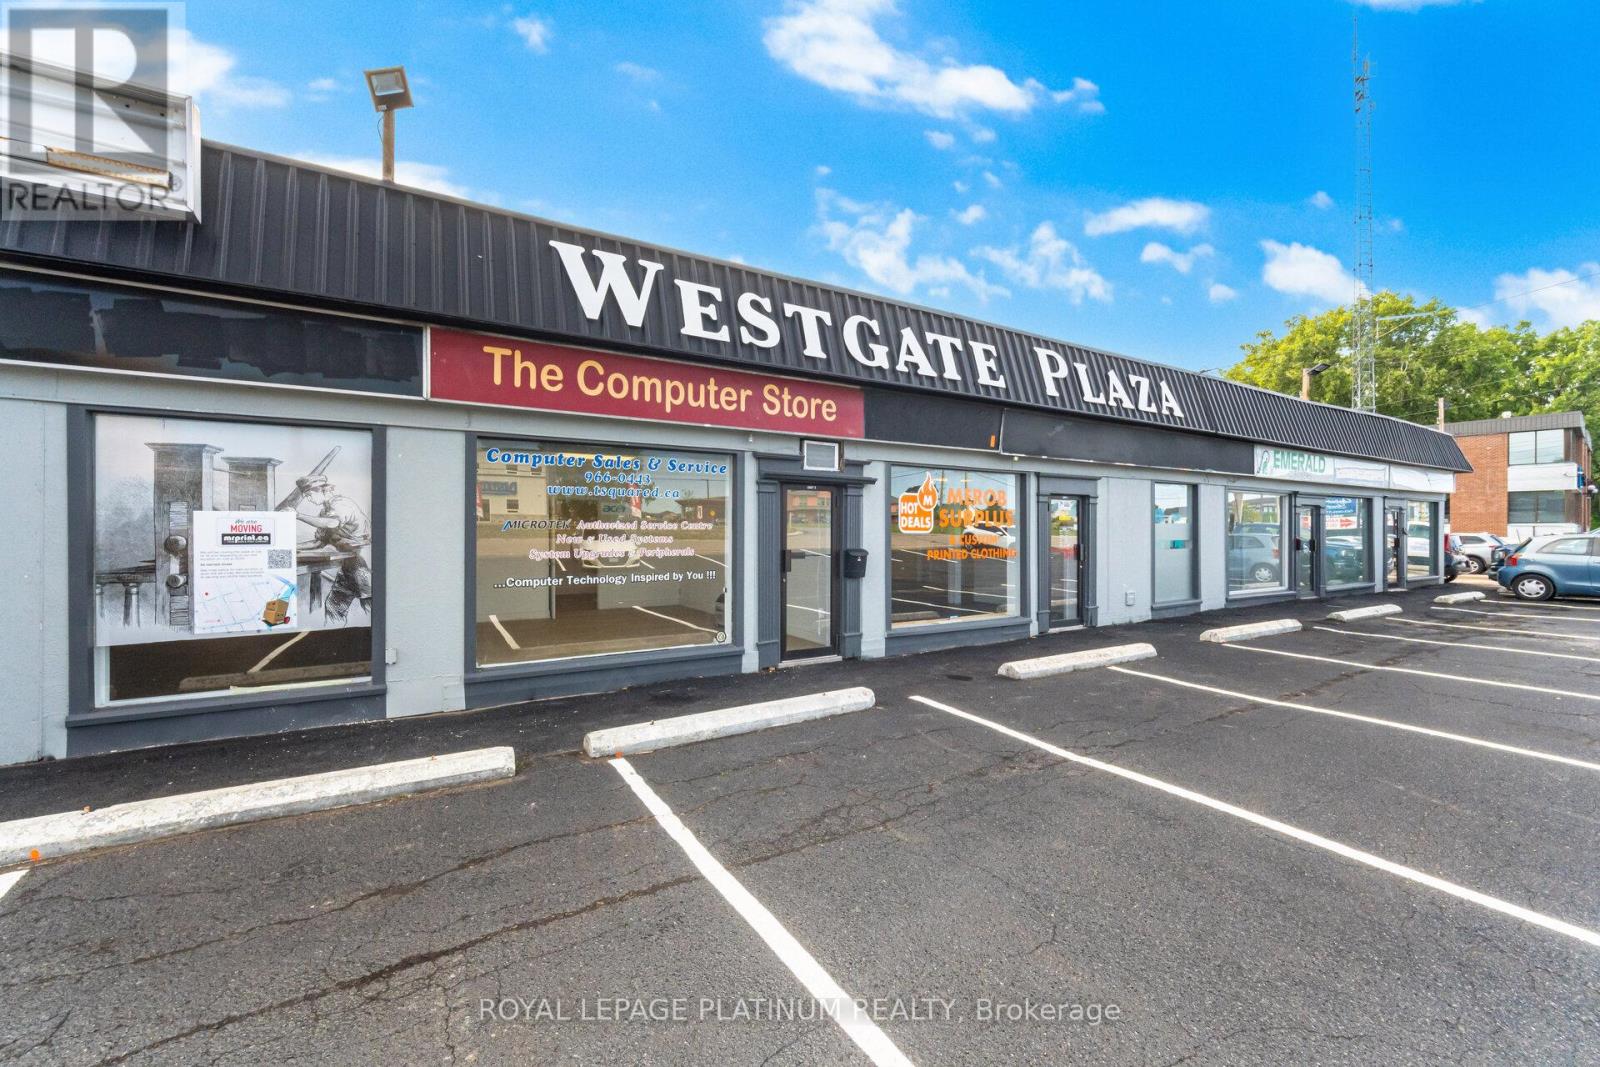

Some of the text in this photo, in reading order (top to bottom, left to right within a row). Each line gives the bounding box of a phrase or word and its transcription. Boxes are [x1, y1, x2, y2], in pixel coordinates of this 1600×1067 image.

[549, 240, 1185, 418] WESTGATE PLAZA
[482, 345, 838, 422] The Computer Store
[486, 447, 728, 474] Computer Sales & Service
[1274, 451, 1326, 472] EMERALD
[584, 471, 652, 486] 966-0443
[546, 484, 681, 499] www.tsquared.ca
[900, 501, 918, 515] HOT
[924, 496, 933, 506] M
[576, 519, 638, 530] Authorized
[640, 520, 678, 530] Service
[900, 516, 931, 528] DEALS
[940, 508, 1014, 528] SURPLUS
[230, 524, 263, 533] MOVING
[500, 519, 572, 532] MICROTEK
[224, 534, 269, 543] mrprint.ca
[556, 533, 583, 545] New
[599, 533, 627, 545] Used
[630, 534, 674, 546] Systems
[528, 548, 571, 561] System
[573, 547, 626, 561] Upgrades
[639, 546, 696, 559] Peripherals
[926, 547, 1017, 560] PRINTED CLOTHING
[567, 573, 628, 586] Technology
[631, 572, 671, 583] Inspired
[673, 571, 684, 582] by
[686, 571, 704, 580] You
[706, 570, 717, 580] !!!
